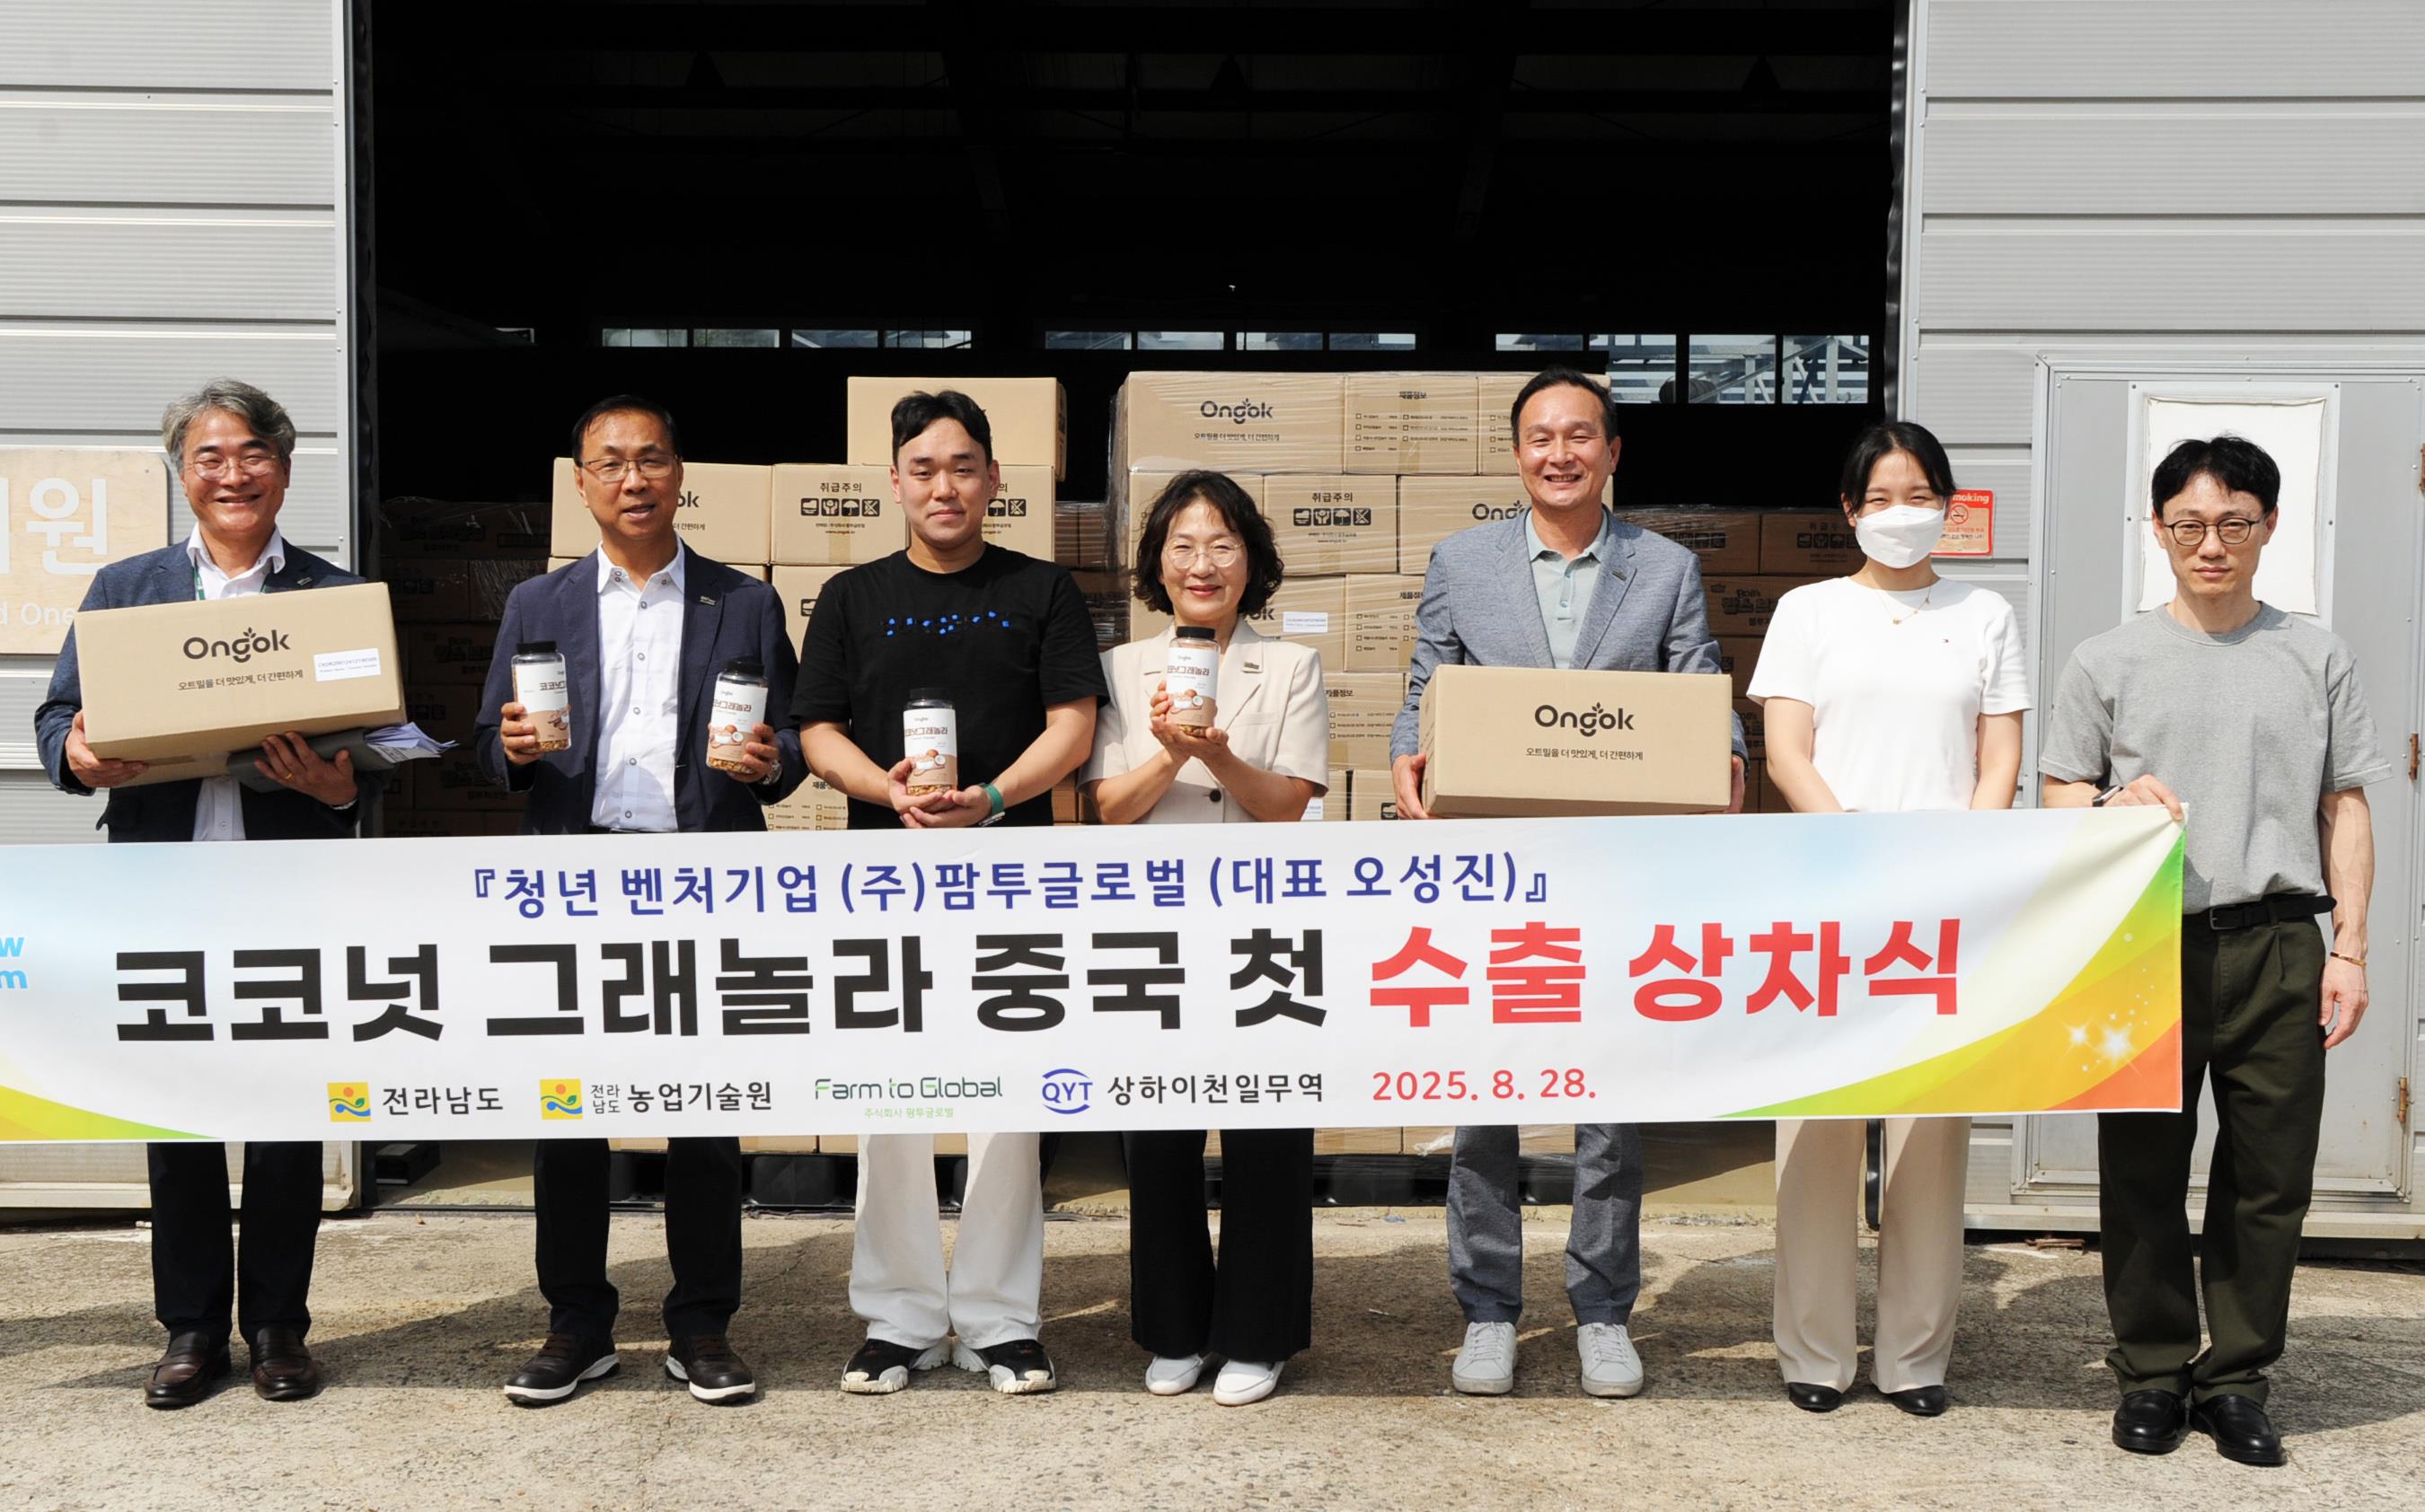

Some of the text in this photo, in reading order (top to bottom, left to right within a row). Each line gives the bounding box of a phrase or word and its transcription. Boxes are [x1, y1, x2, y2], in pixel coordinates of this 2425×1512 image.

[1200, 400, 1274, 425] Ongok
[820, 482, 862, 493] 취급주의
[1312, 492, 1354, 503] 취급주의
[1952, 492, 1989, 505] moking
[0, 477, 108, 575] 원
[183, 628, 292, 664] Ongok
[179, 669, 304, 690] 오트밀을 더 맛있게, 더 간편하게
[1535, 703, 1635, 737] Ongok
[1525, 747, 1644, 761] 오트밀을 더 맛있게, 더 간편하게
[622, 865, 817, 915] 벤처기업
[841, 859, 1186, 914] (주)팜투글로벌
[1210, 856, 1327, 908] (대표
[116, 918, 1961, 1042] 코코넛 그래놀라 중국 첫 수출 상차식
[590, 1084, 621, 1099] 전라
[627, 1081, 772, 1113] 농업기술원
[815, 1076, 1003, 1100] Farm to Global
[1042, 1081, 1093, 1103] QYT
[1107, 1073, 1323, 1106] 상하이천일무역
[1373, 1068, 1596, 1102] 2025. 8. 28.
[382, 1086, 504, 1116] 전라남도
[592, 1099, 621, 1114] 남도
[864, 1107, 903, 1119] 주식회사
